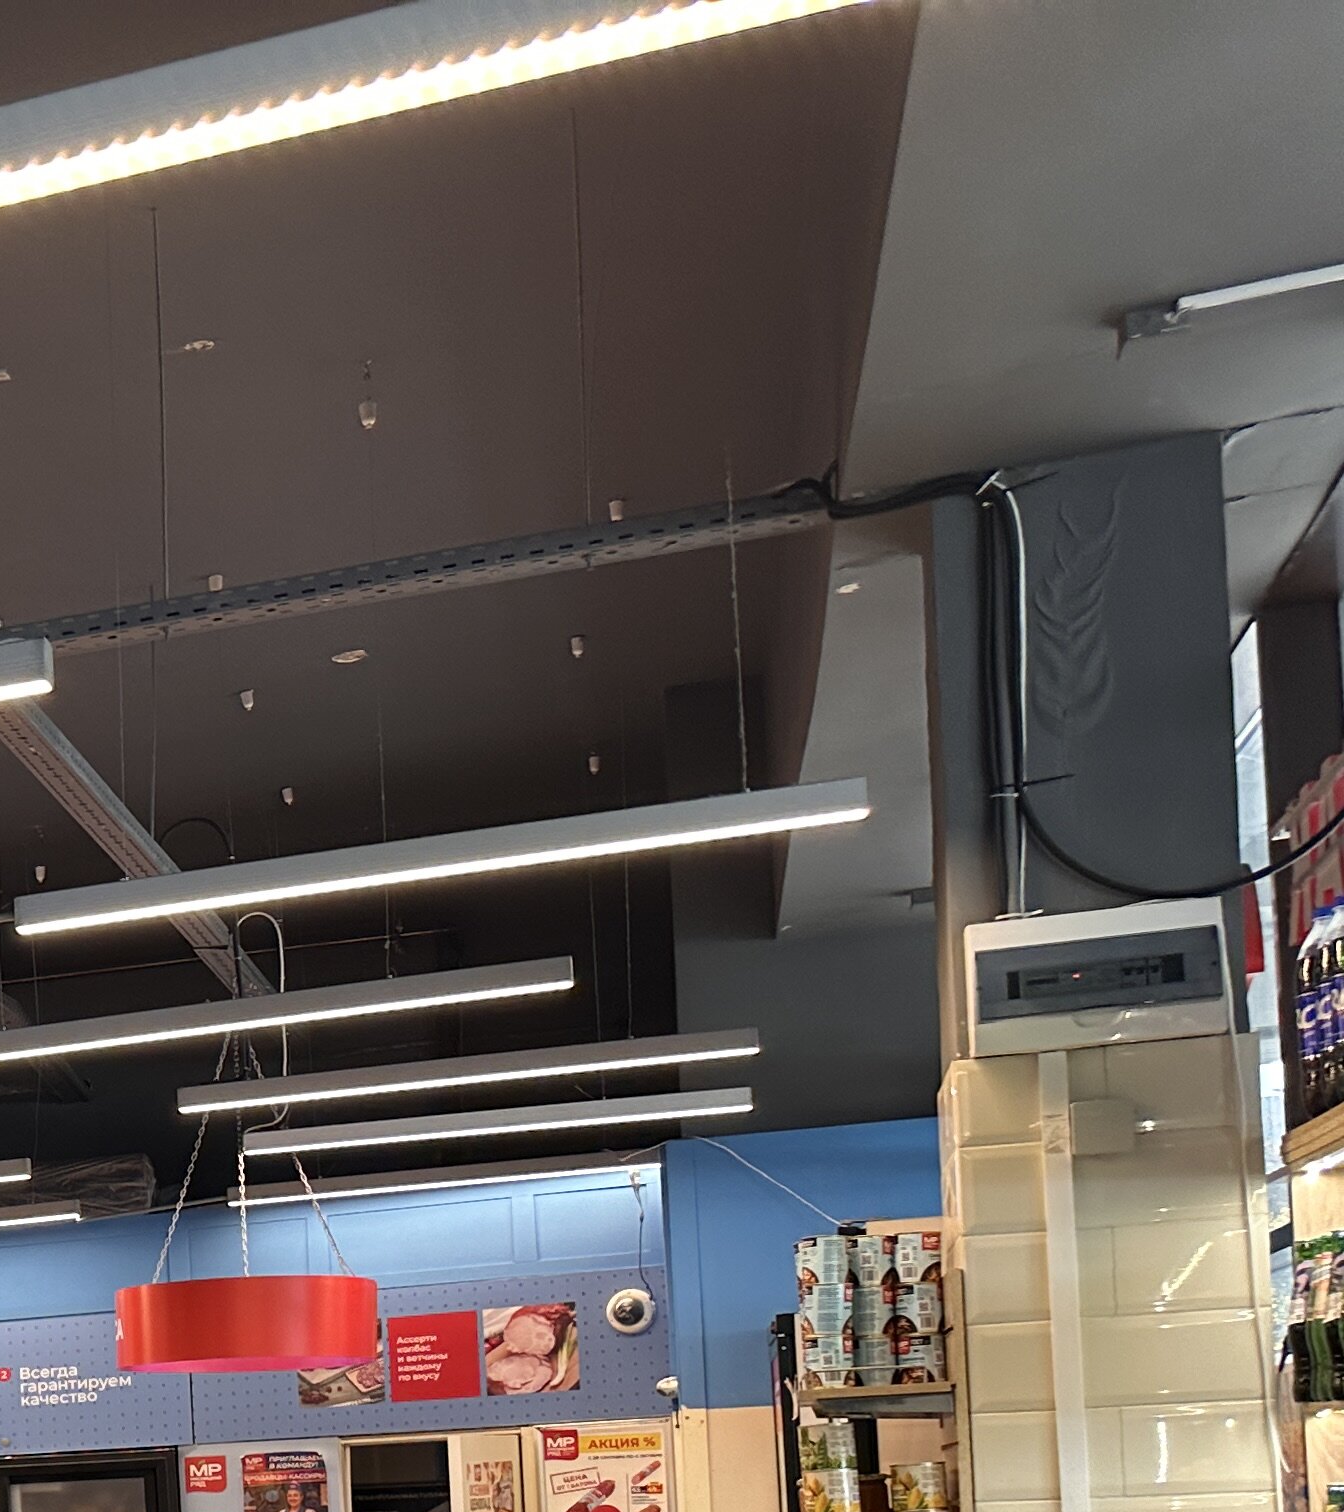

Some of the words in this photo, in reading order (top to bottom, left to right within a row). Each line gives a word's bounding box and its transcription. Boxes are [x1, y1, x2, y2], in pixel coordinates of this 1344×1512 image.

[19, 1364, 78, 1381] Всегда
[20, 1375, 132, 1394] гарантируем
[21, 1391, 98, 1407] качество
[588, 1437, 640, 1449] АКЦИЯ
[563, 1473, 588, 1483] ЦЕНА
